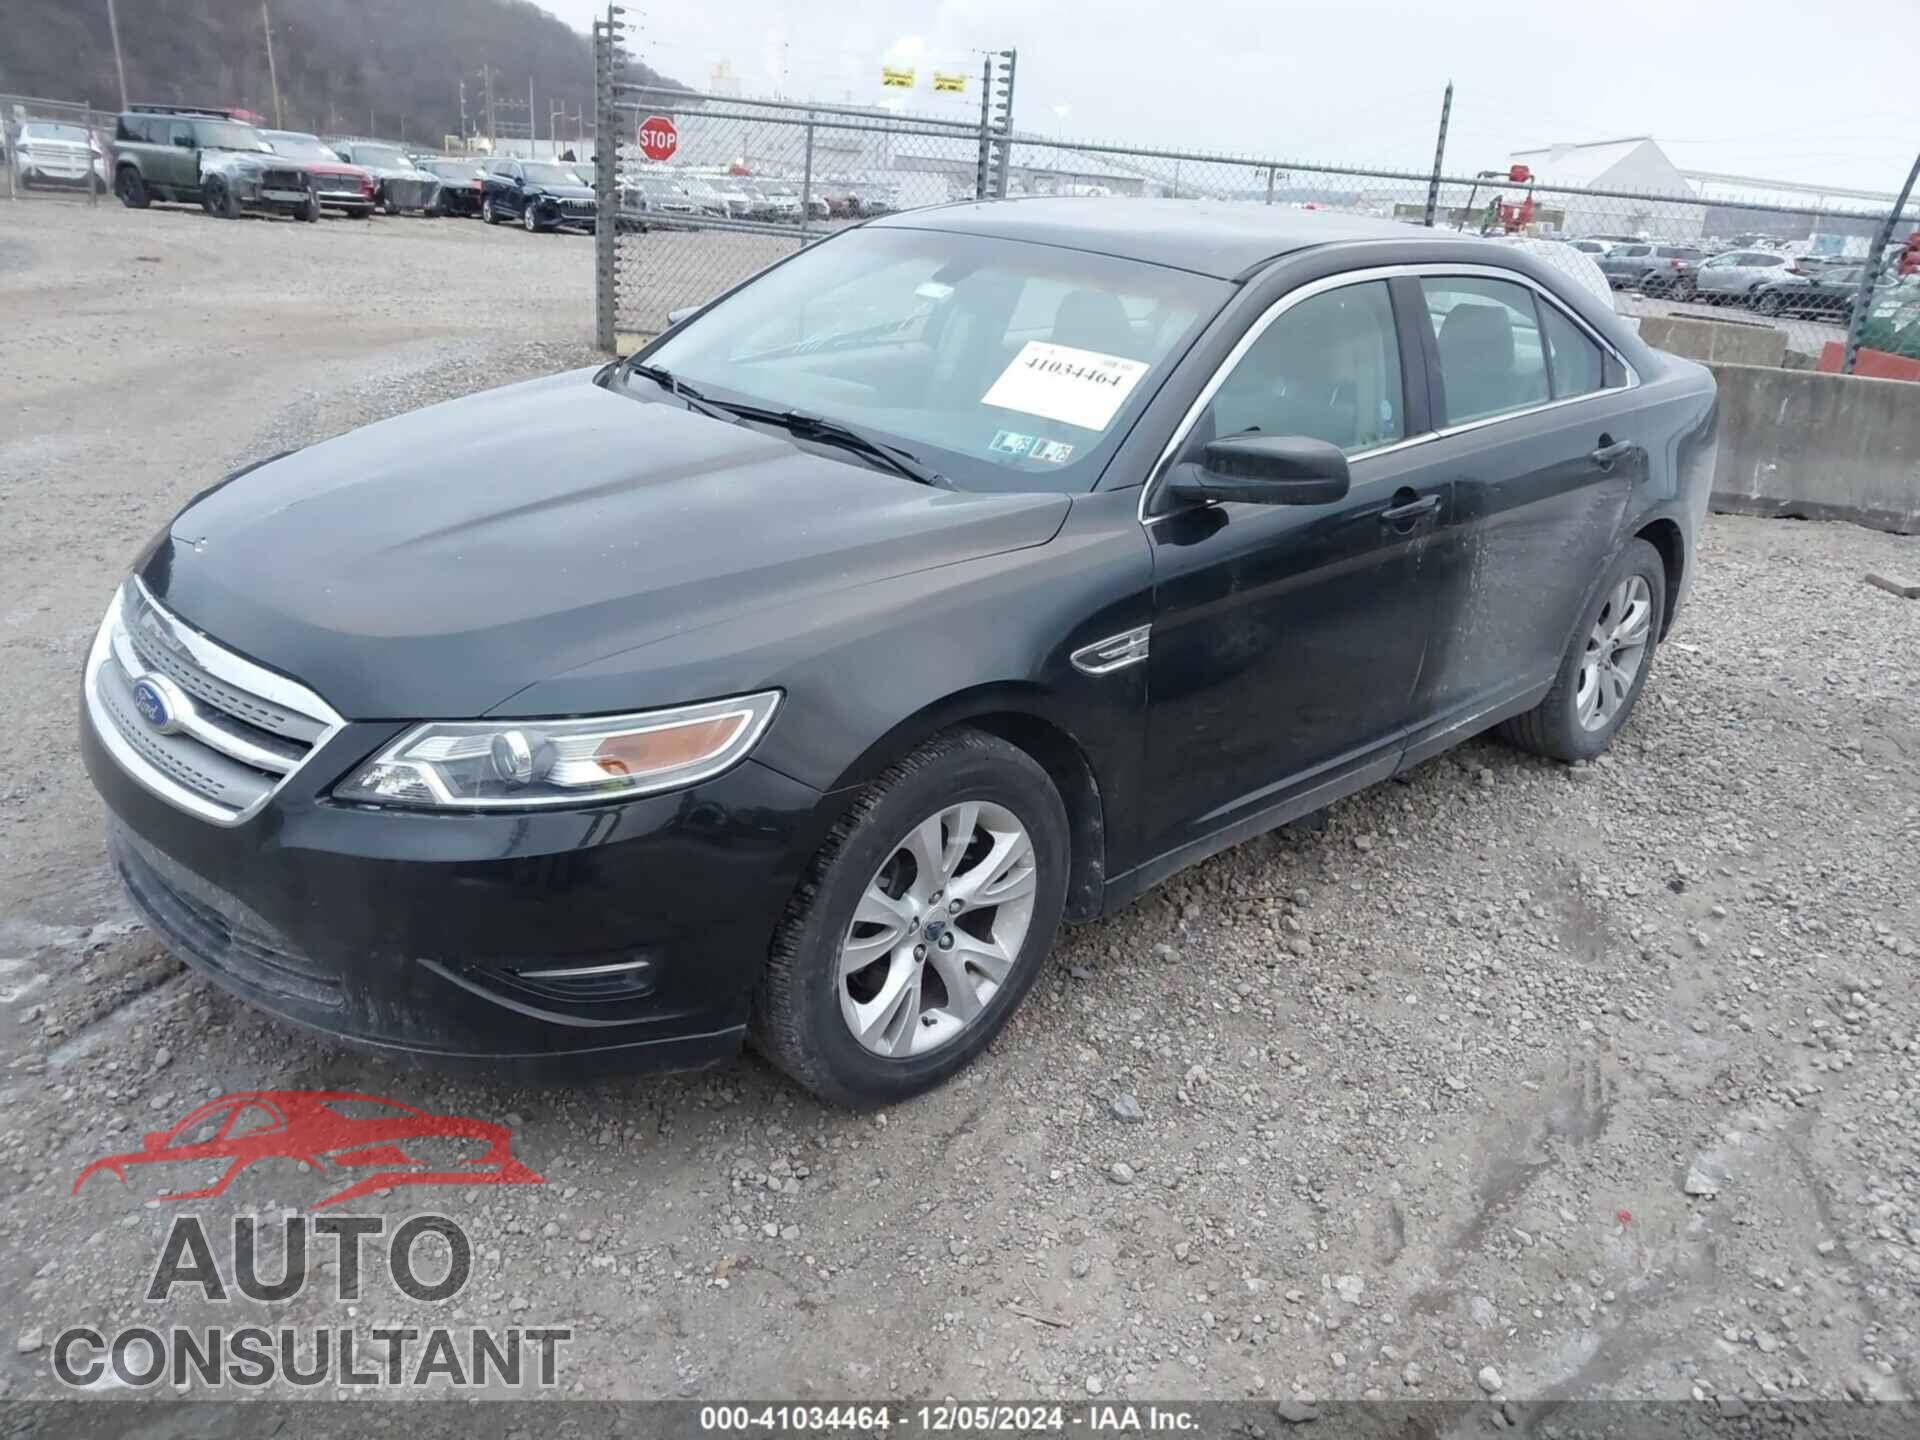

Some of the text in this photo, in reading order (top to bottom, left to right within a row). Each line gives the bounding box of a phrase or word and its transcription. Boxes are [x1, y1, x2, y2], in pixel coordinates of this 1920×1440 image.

[641, 130, 676, 149] STOP
[1025, 357, 1122, 387] 41034464
[135, 687, 159, 720] Ford
